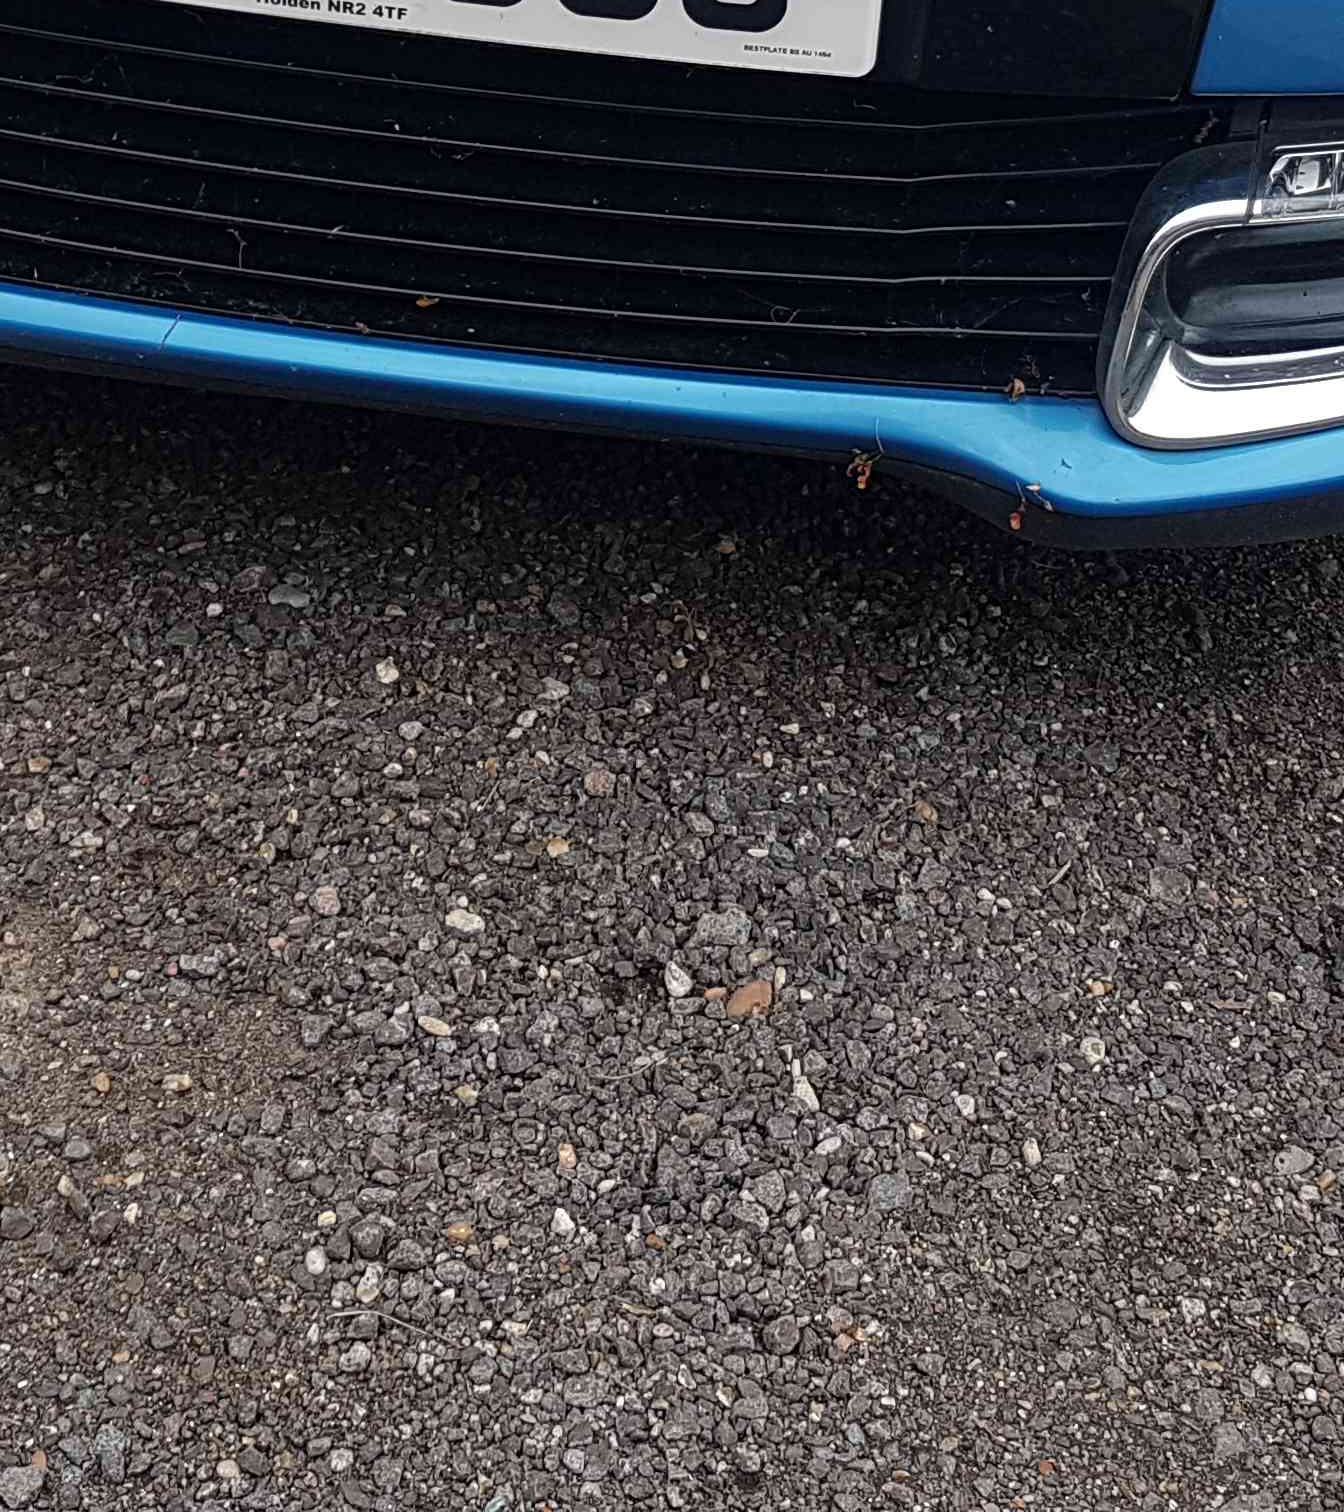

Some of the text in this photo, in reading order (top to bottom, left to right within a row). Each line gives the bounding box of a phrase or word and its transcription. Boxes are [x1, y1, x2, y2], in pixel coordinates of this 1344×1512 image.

[327, 0, 366, 16] NR2
[372, 5, 408, 20] 4TF
[744, 44, 787, 54] BESTPLATE
